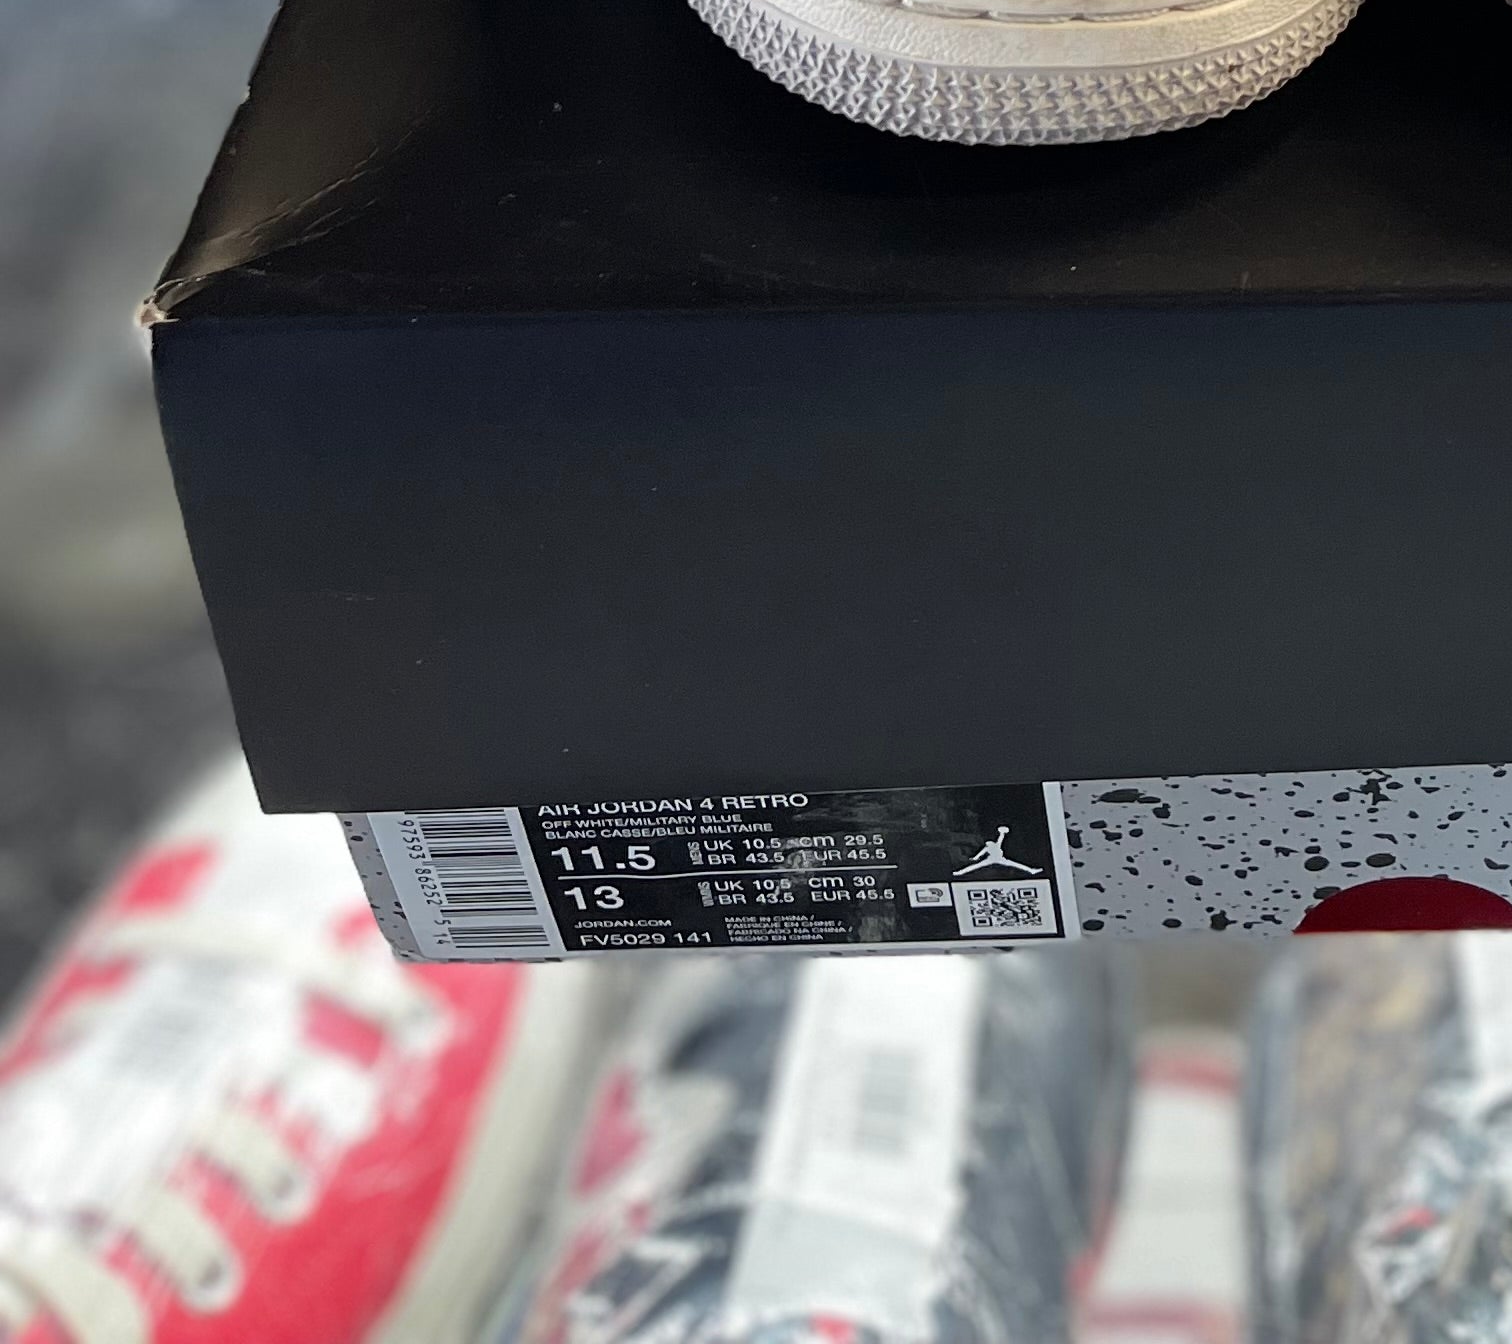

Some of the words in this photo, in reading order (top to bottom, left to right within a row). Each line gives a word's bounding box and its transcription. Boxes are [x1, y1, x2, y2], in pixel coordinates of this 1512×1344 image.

[587, 798, 693, 816] JORDAN
[699, 797, 715, 811] 4
[722, 793, 809, 810] RETRO
[541, 819, 572, 830] OFF
[575, 815, 697, 829] WHITE/MILITARY
[702, 813, 743, 824] BLUE
[545, 828, 597, 840] BLANC
[700, 822, 773, 834] MILITAIRE
[704, 839, 734, 851] UK
[742, 838, 782, 850] 10.5
[799, 835, 836, 848] cm
[844, 834, 884, 847] 29.5
[551, 845, 656, 872] 11.5
[707, 853, 737, 865] BR
[745, 851, 785, 864] 43.5
[802, 849, 842, 862] EUR
[847, 848, 887, 860] 45.5
[415, 867, 443, 906] 86252
[714, 880, 744, 892] UK
[752, 878, 792, 891] 10.5
[808, 876, 844, 888] cm
[853, 875, 876, 887] 30
[564, 885, 624, 910] 13
[718, 894, 747, 905] BR
[755, 892, 795, 904] 43.5
[811, 890, 851, 902] EUR
[856, 888, 895, 900] 45.5
[574, 919, 672, 929] JORDAN.COM
[580, 933, 666, 947] FV5029
[673, 931, 712, 944] 141
[789, 933, 824, 941] CHINA
